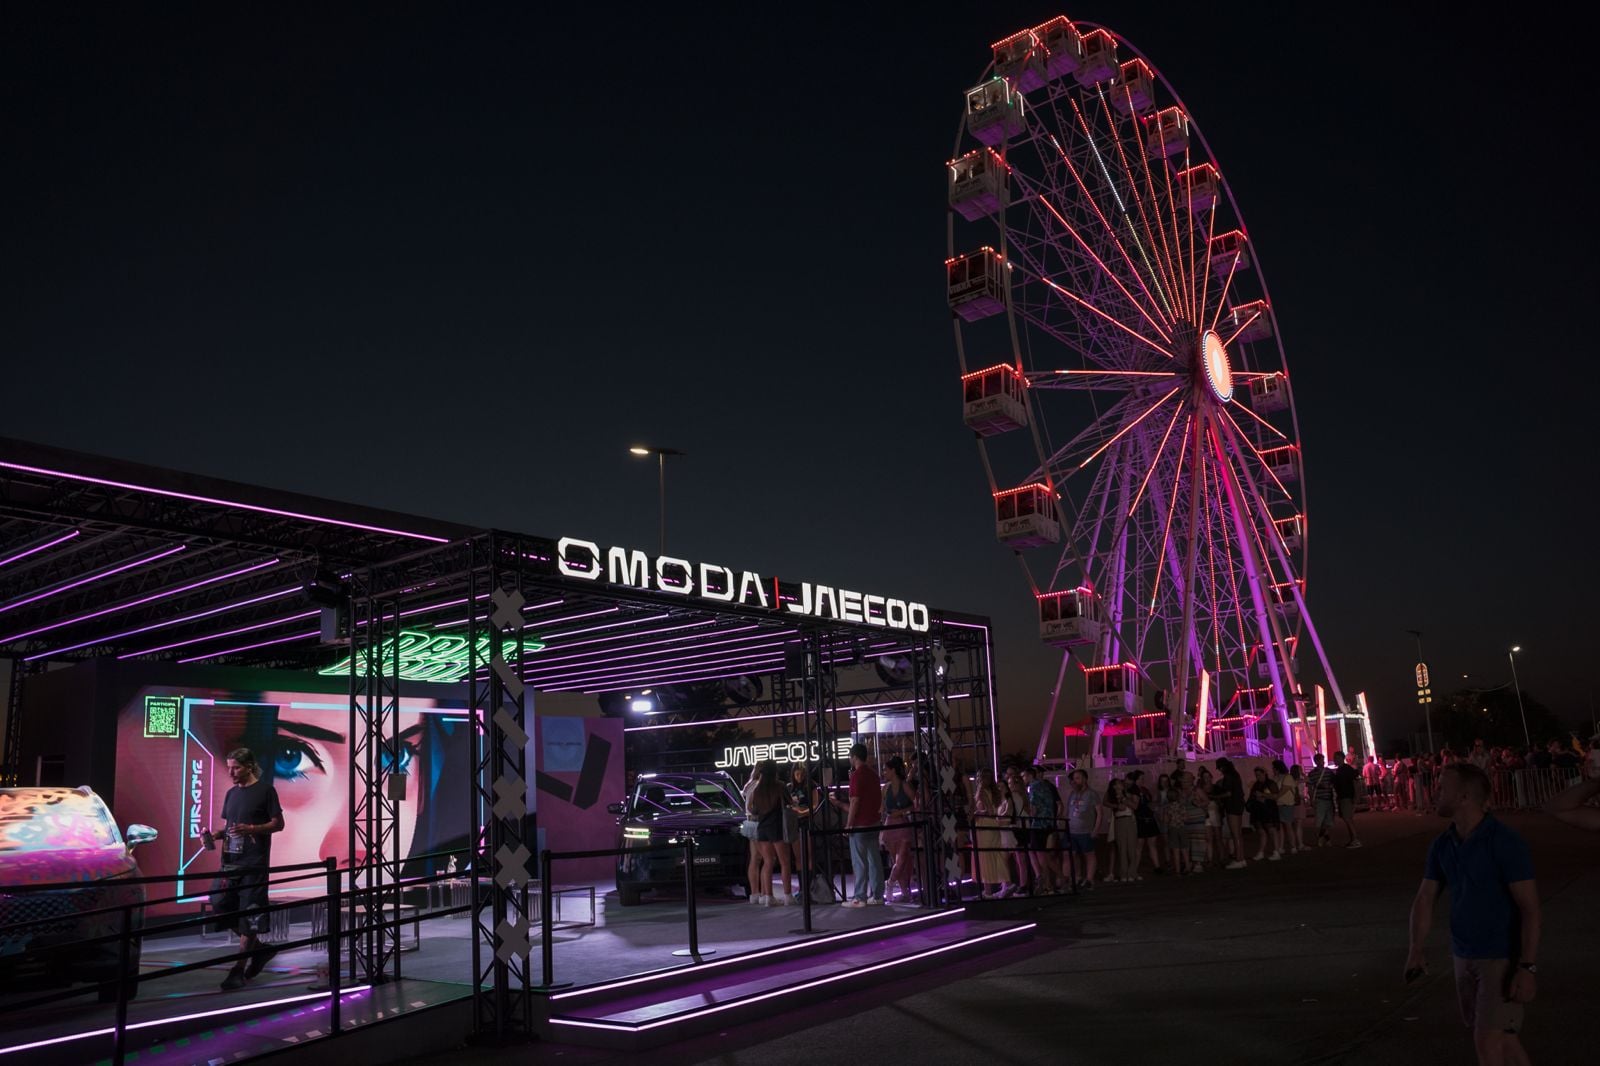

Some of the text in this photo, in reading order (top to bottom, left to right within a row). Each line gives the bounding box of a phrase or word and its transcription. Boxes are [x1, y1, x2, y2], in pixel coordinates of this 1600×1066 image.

[558, 537, 929, 632] OMODA JAECOO
[190, 760, 203, 838] PIRATE
